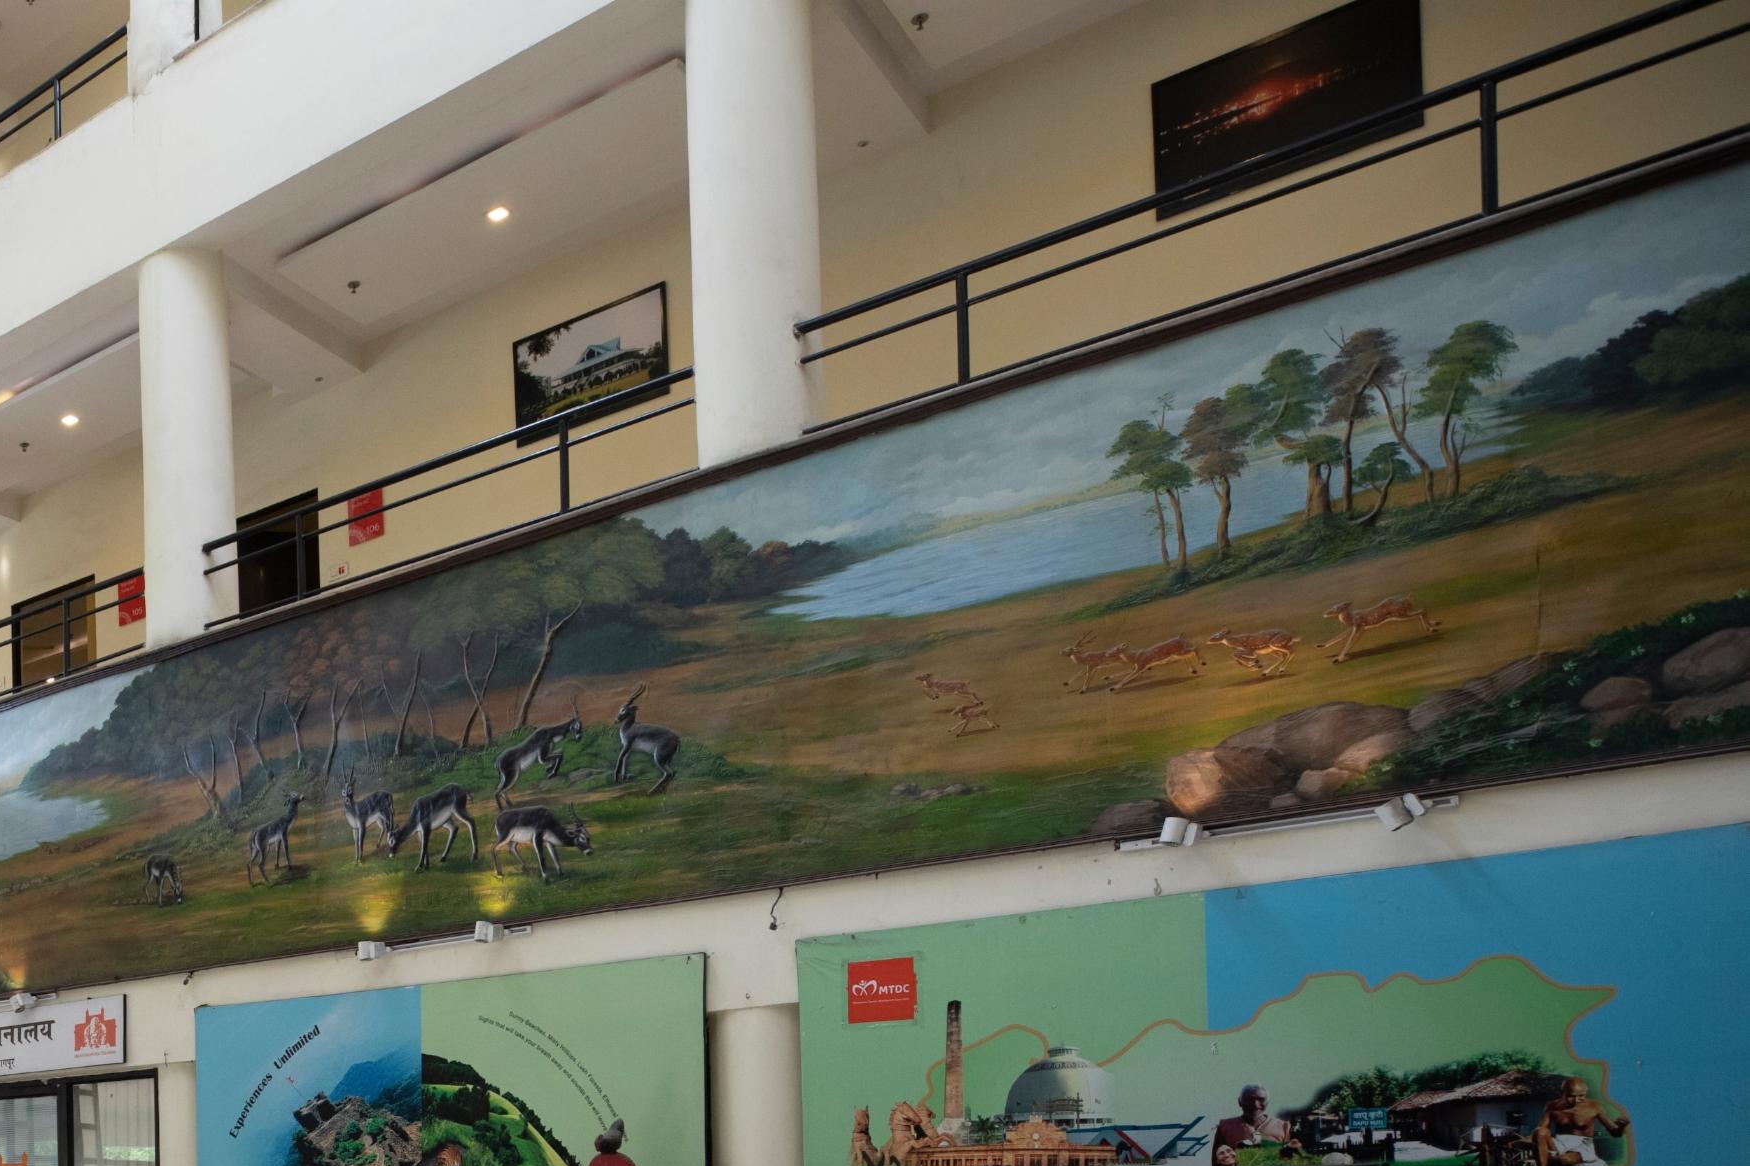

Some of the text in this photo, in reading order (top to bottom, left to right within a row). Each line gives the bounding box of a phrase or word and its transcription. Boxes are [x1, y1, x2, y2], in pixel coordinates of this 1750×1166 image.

[366, 523, 379, 534] 106
[878, 983, 910, 995] MTDC
[229, 1024, 320, 1139] Experiences Unlimited
